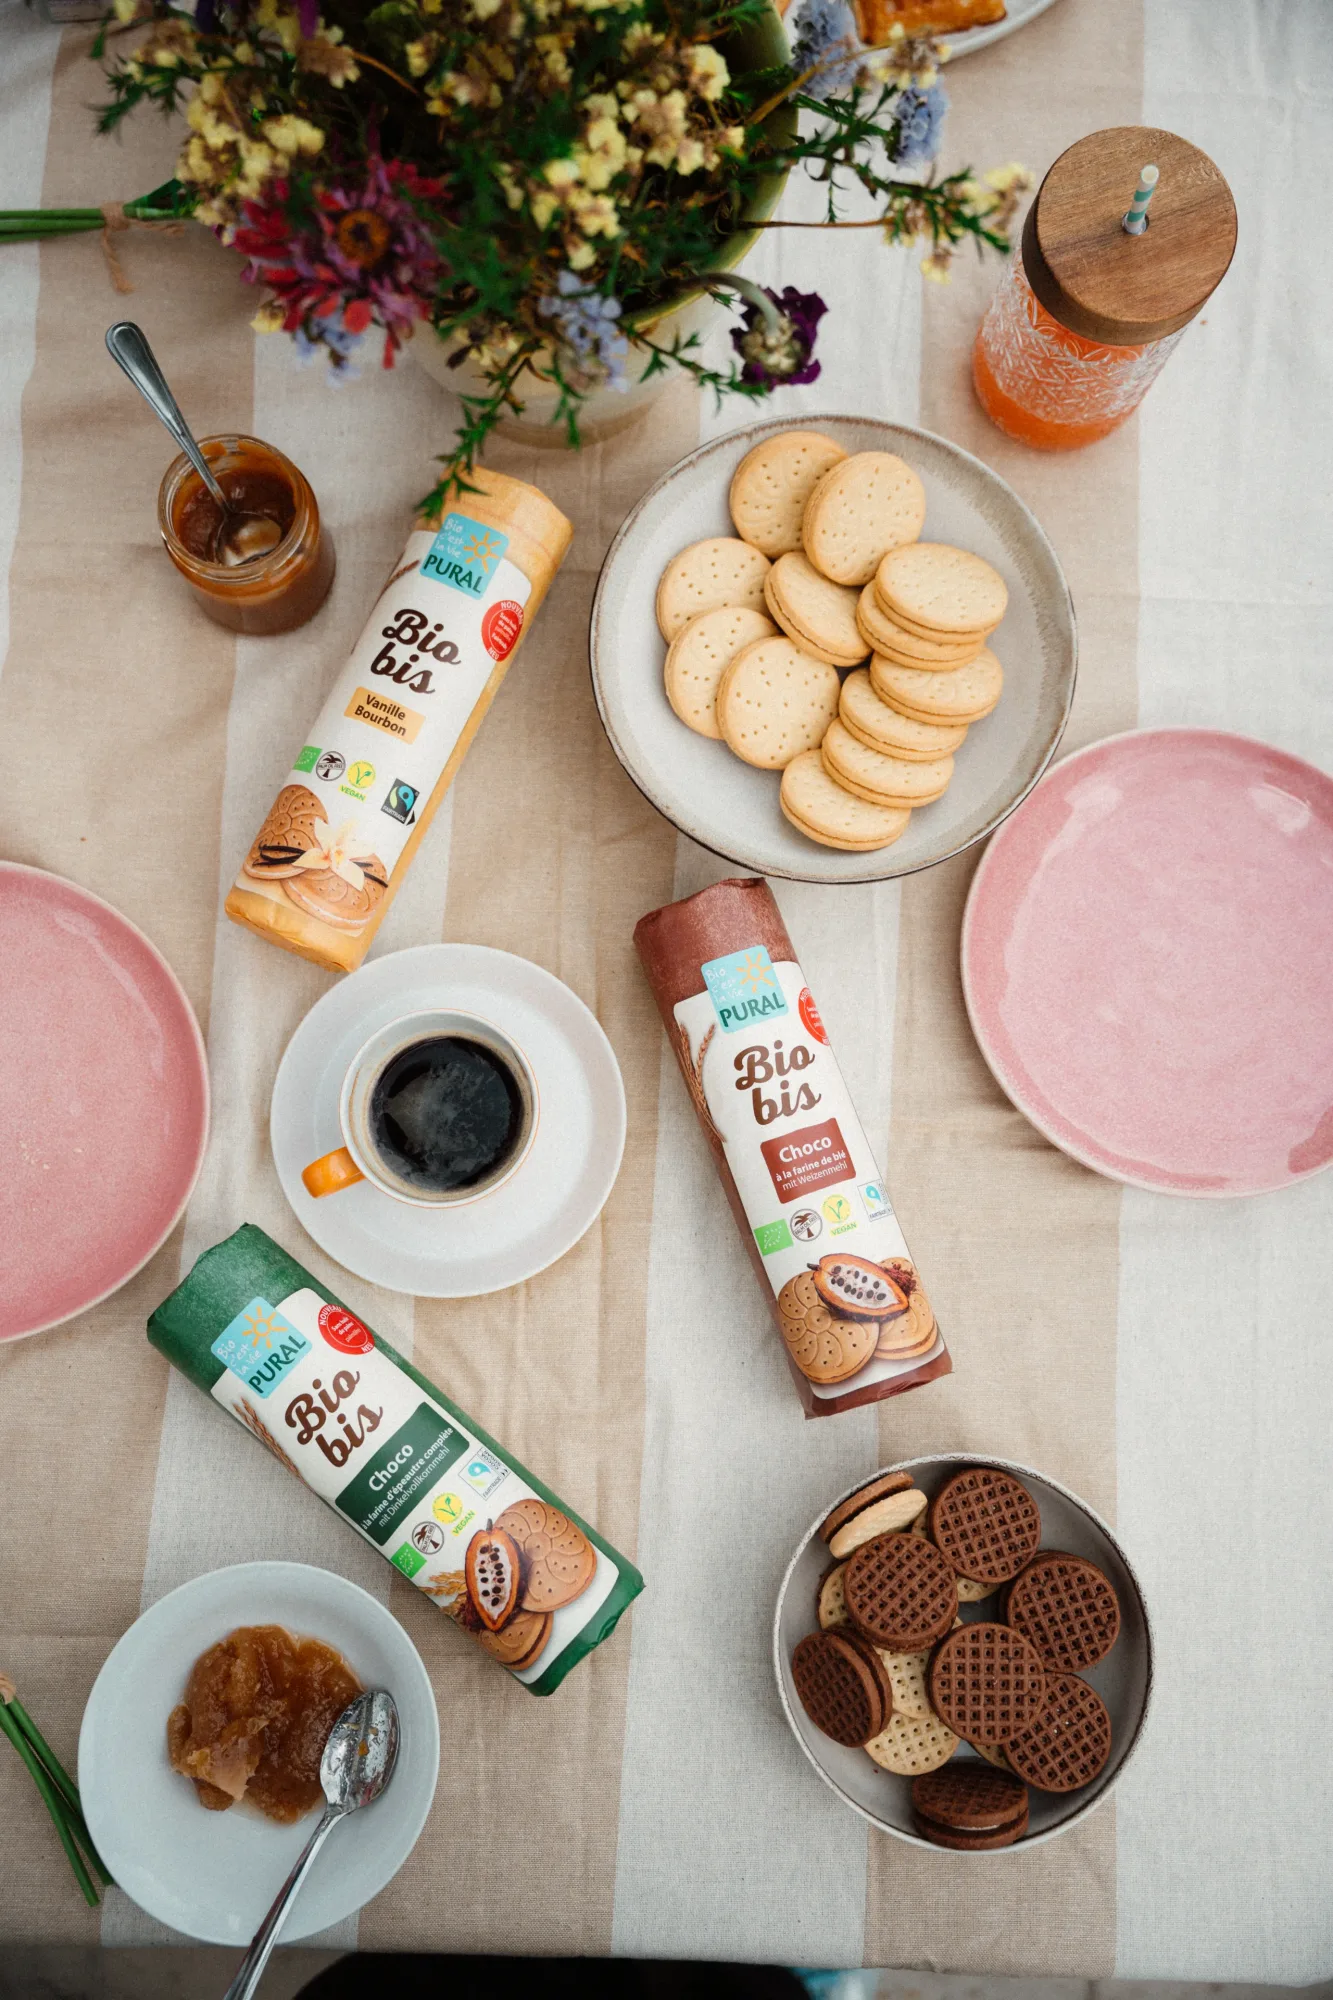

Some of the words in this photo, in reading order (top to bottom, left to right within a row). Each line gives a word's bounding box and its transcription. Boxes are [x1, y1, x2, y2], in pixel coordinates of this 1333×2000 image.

[423, 554, 485, 594] PURAL
[382, 608, 462, 665] Bio
[370, 641, 436, 694] bis
[354, 705, 407, 736] Bourbon
[366, 694, 406, 721] Vanille
[341, 785, 366, 801] VEGAN
[720, 992, 785, 1028] PURAL
[734, 1040, 816, 1090] Bio
[752, 1080, 822, 1126] bis
[779, 1136, 832, 1162] Choco
[782, 1170, 792, 1180] la
[792, 1161, 820, 1176] farine
[821, 1156, 832, 1166] de
[832, 1150, 846, 1162] blé
[782, 1180, 798, 1191] mit
[797, 1160, 848, 1184] Weizenmehl
[831, 1222, 858, 1236] VEGAN
[248, 1335, 306, 1394] PURAL
[284, 1370, 360, 1446] Bio
[315, 1404, 383, 1468] bis
[364, 1517, 372, 1526] la
[368, 1498, 390, 1520] farine
[386, 1458, 426, 1501] d'épeautre
[424, 1427, 454, 1460] complète
[368, 1444, 414, 1491] Choco
[378, 1512, 391, 1528] mit
[386, 1445, 450, 1516] Dinkelvollkornmehl
[452, 1510, 476, 1534] VEGAN
